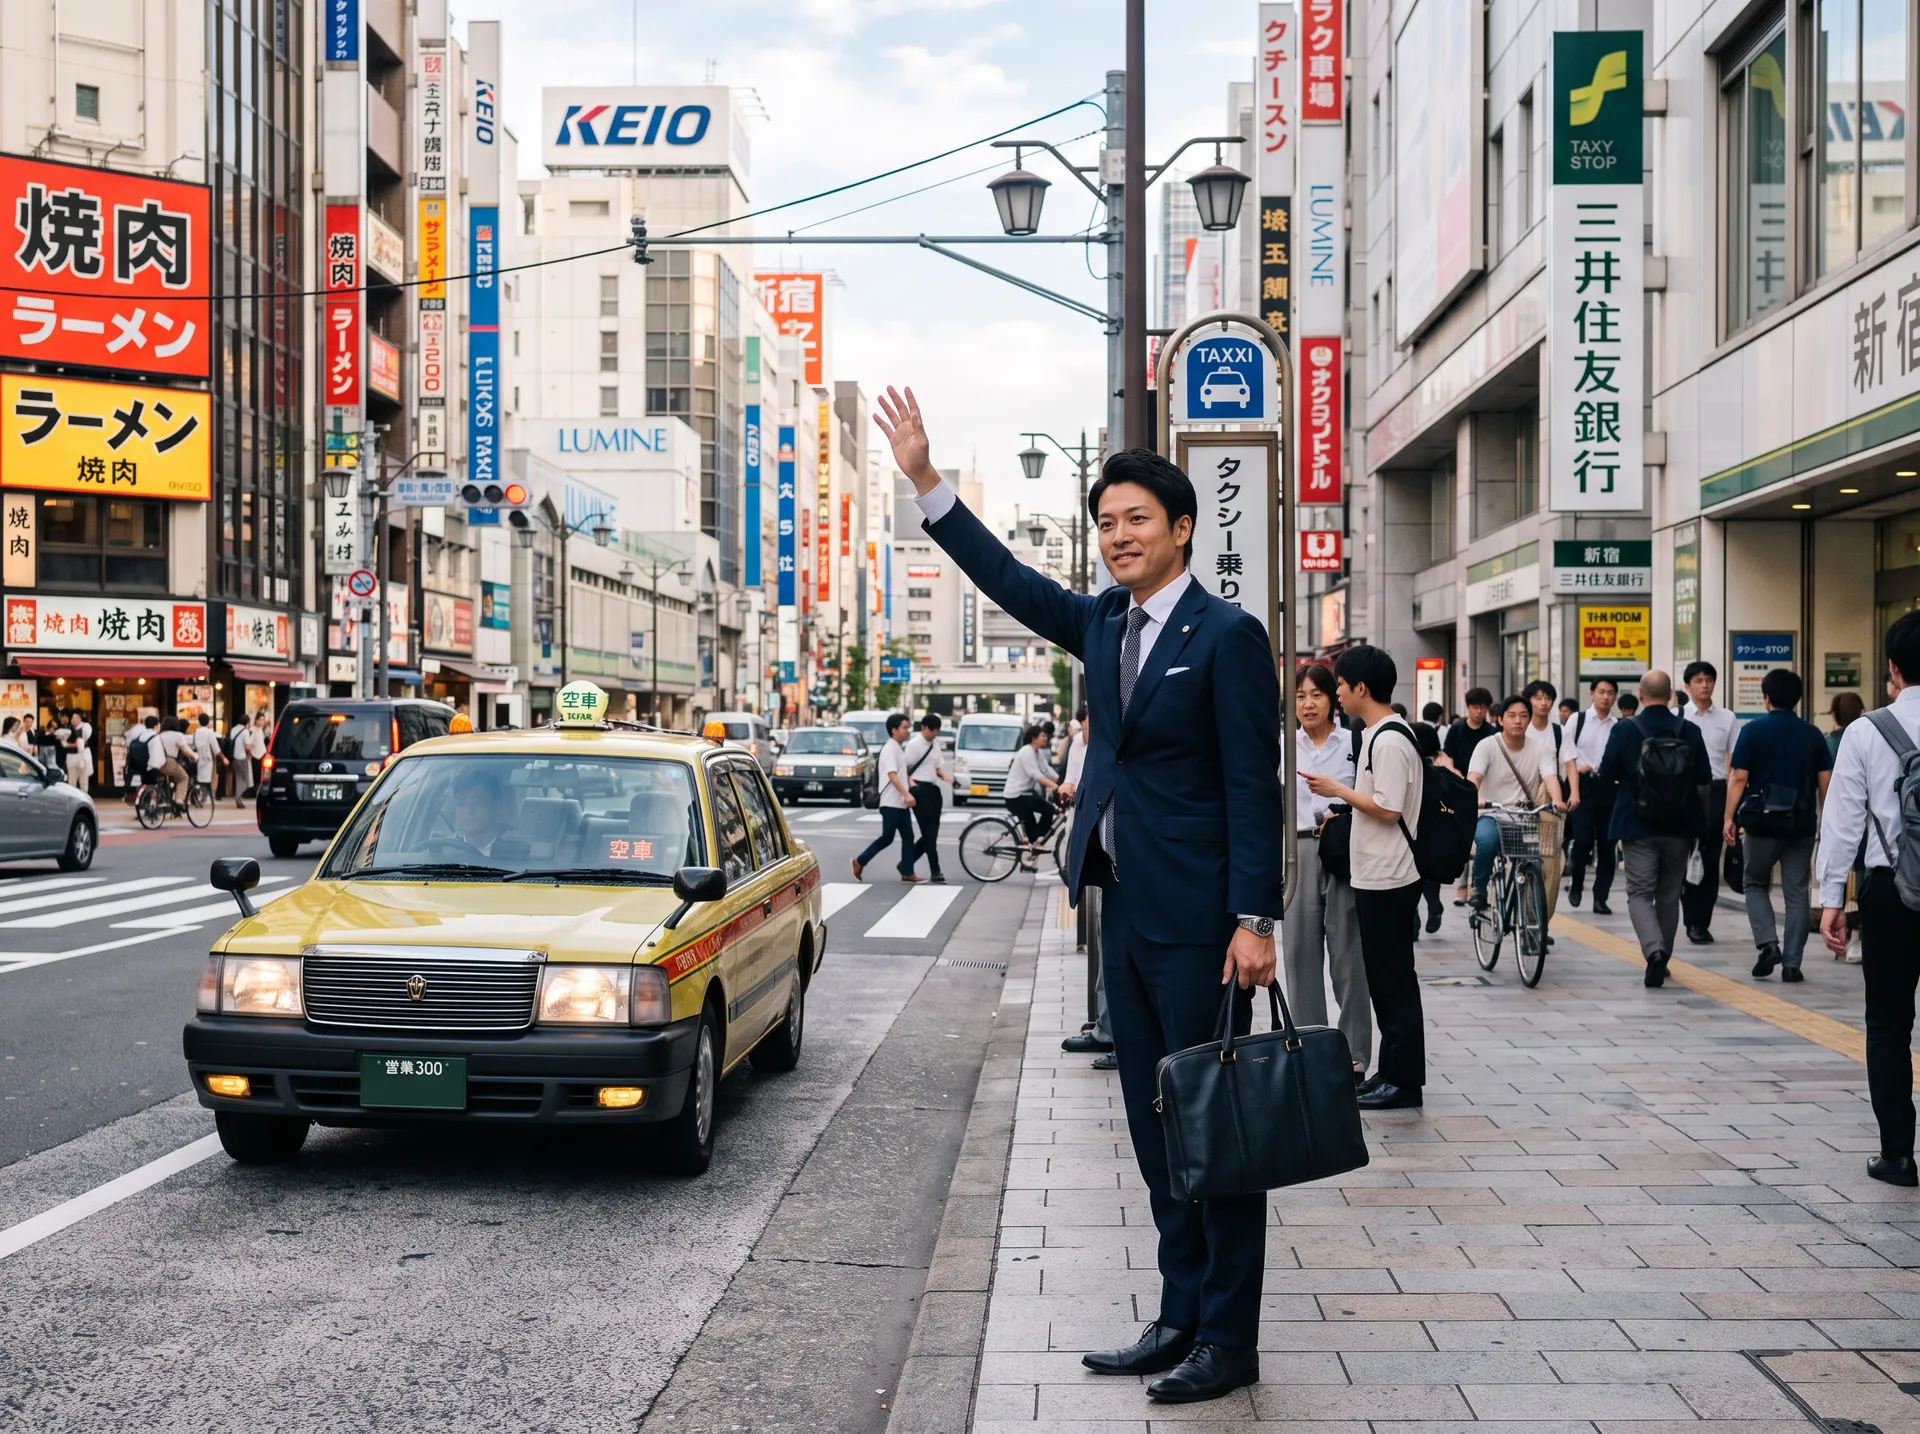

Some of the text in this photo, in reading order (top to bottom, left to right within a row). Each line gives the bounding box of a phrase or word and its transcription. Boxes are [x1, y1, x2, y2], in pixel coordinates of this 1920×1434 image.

[1264, 20, 1287, 153] クチースン
[476, 79, 494, 145] KEIO
[555, 105, 711, 146] KEIO
[1570, 140, 1613, 154] TAXY
[1570, 156, 1617, 169] STOP
[15, 182, 191, 290] 焼肉
[1310, 185, 1334, 287] LUMINE
[330, 234, 355, 287] 焼肉
[13, 296, 196, 358] ラーメン
[332, 308, 354, 395] ラーメン
[1197, 347, 1253, 363] TAXXI
[1573, 203, 1621, 494] 三井住友銀行
[14, 388, 199, 454] ラーメン
[558, 428, 667, 452] LUMINE
[77, 456, 137, 485] 焼肉
[8, 507, 30, 558] 焼肉
[1216, 457, 1244, 608] タクシー乗り
[1584, 547, 1620, 563] 新宿
[1560, 573, 1643, 587] 三井住友銀行
[43, 612, 89, 635] 焼肉
[98, 607, 165, 643] 焼肉
[562, 691, 597, 709] 空車
[609, 839, 654, 860] 空車
[385, 1060, 443, 1076] 営業300
